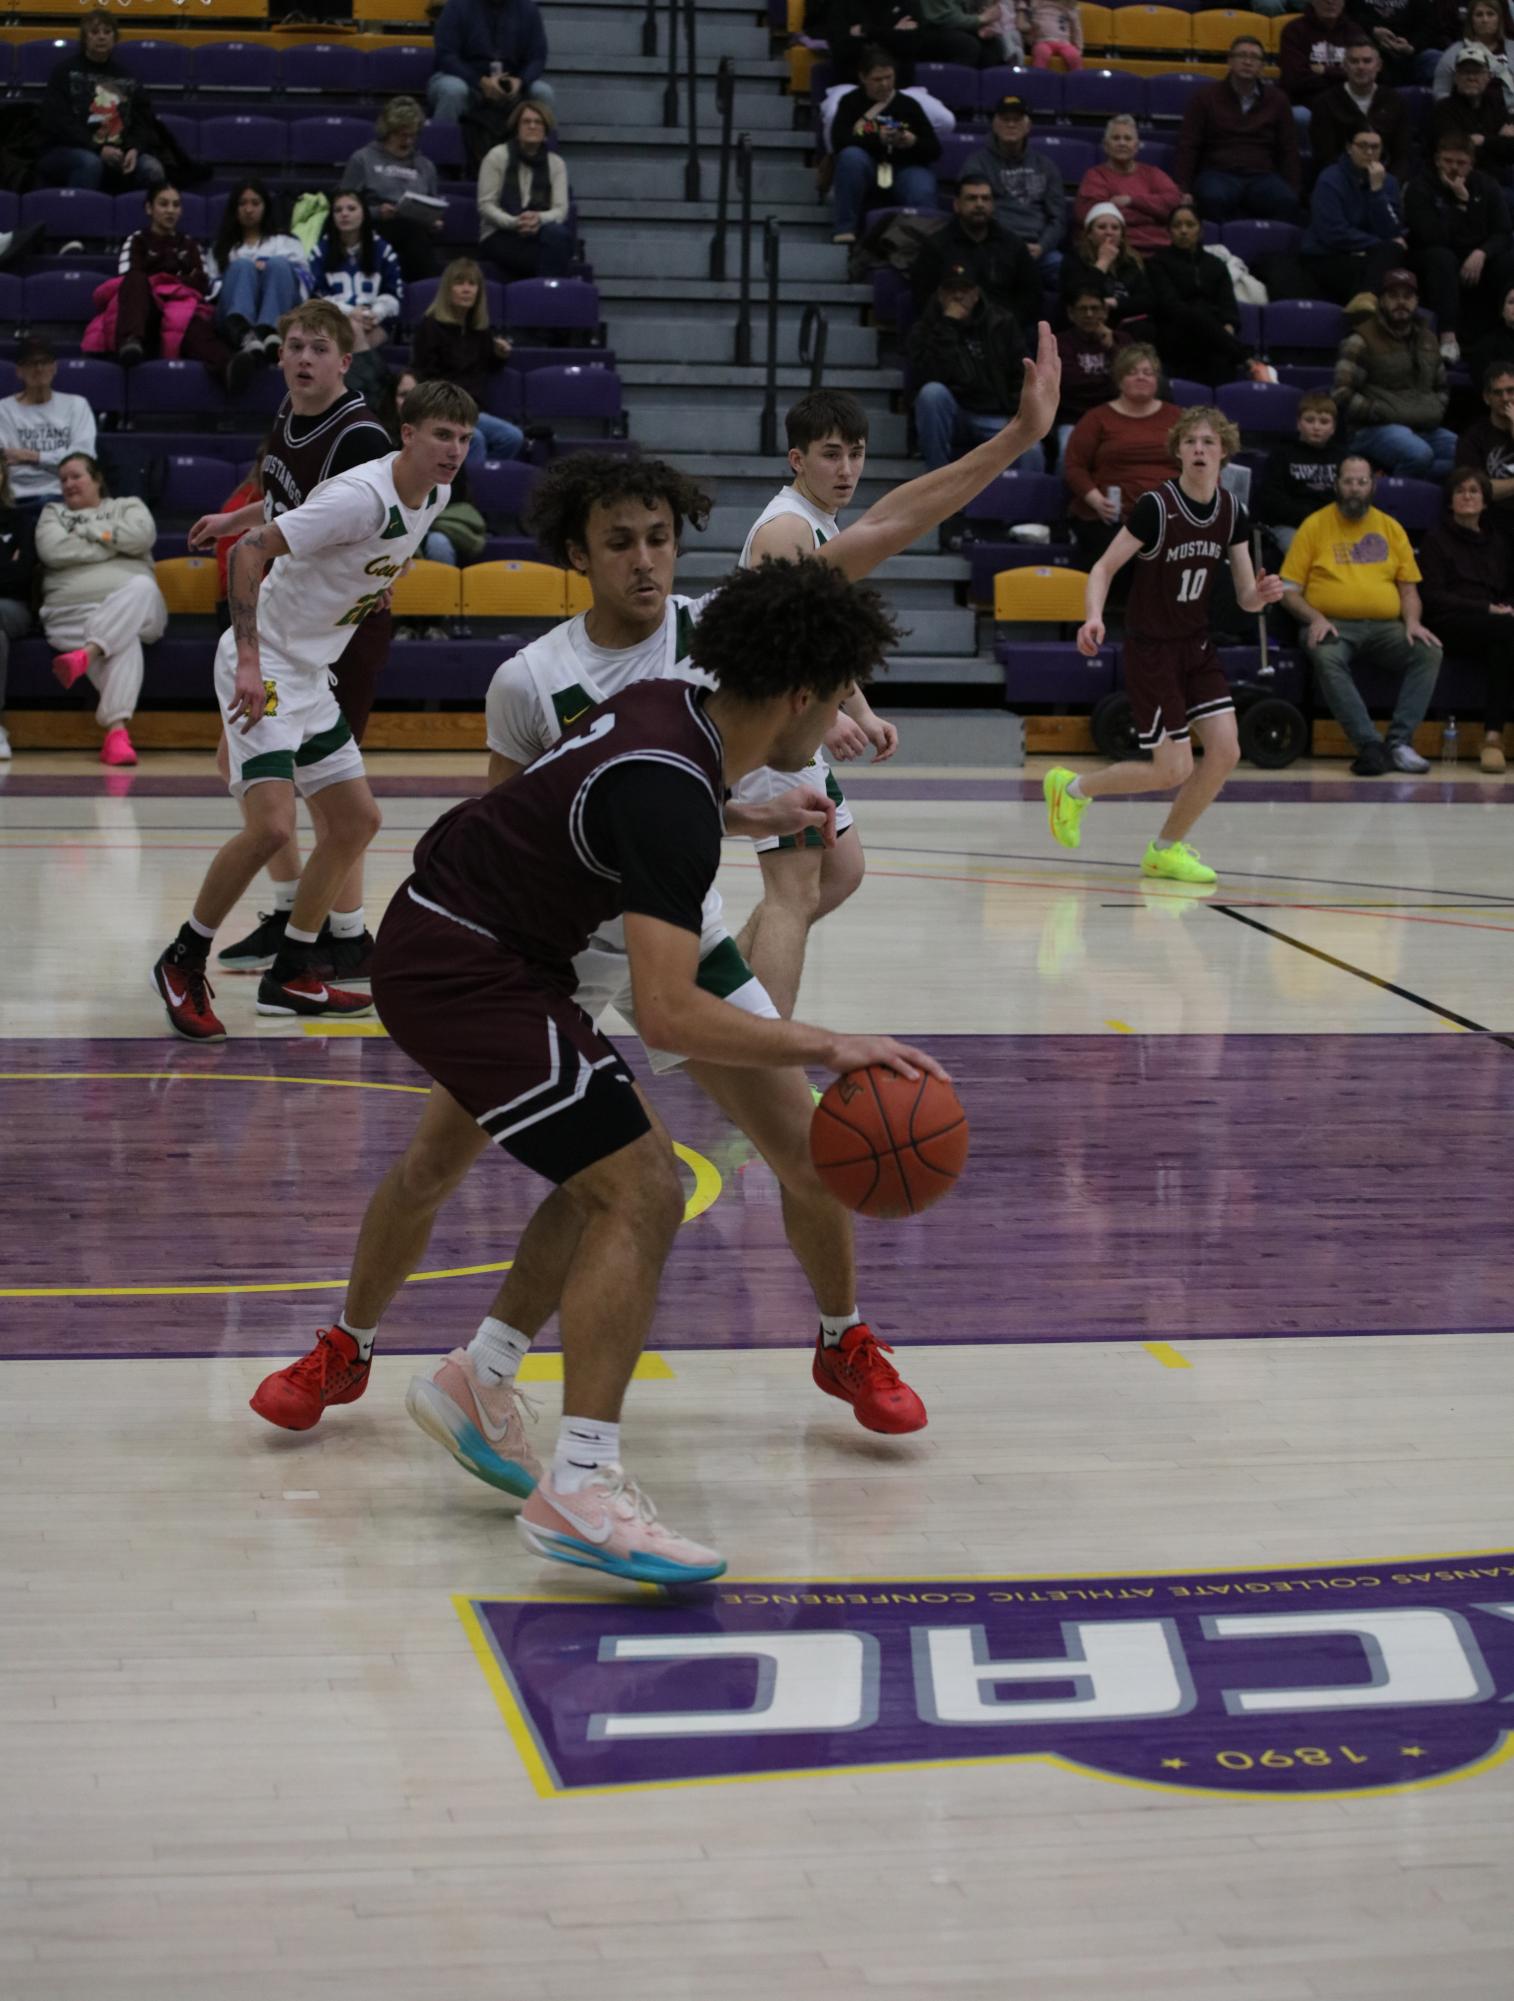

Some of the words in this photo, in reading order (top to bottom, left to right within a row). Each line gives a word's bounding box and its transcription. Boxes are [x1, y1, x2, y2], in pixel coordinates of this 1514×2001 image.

[1176, 567, 1208, 602] 10
[722, 1592, 977, 1606] CONFERENCE
[987, 1586, 1154, 1604] ATHLETIC
[1168, 1576, 1382, 1598] COLLEGIATE
[586, 1601, 1514, 1741] CAC
[1215, 1745, 1369, 1771] 1890
